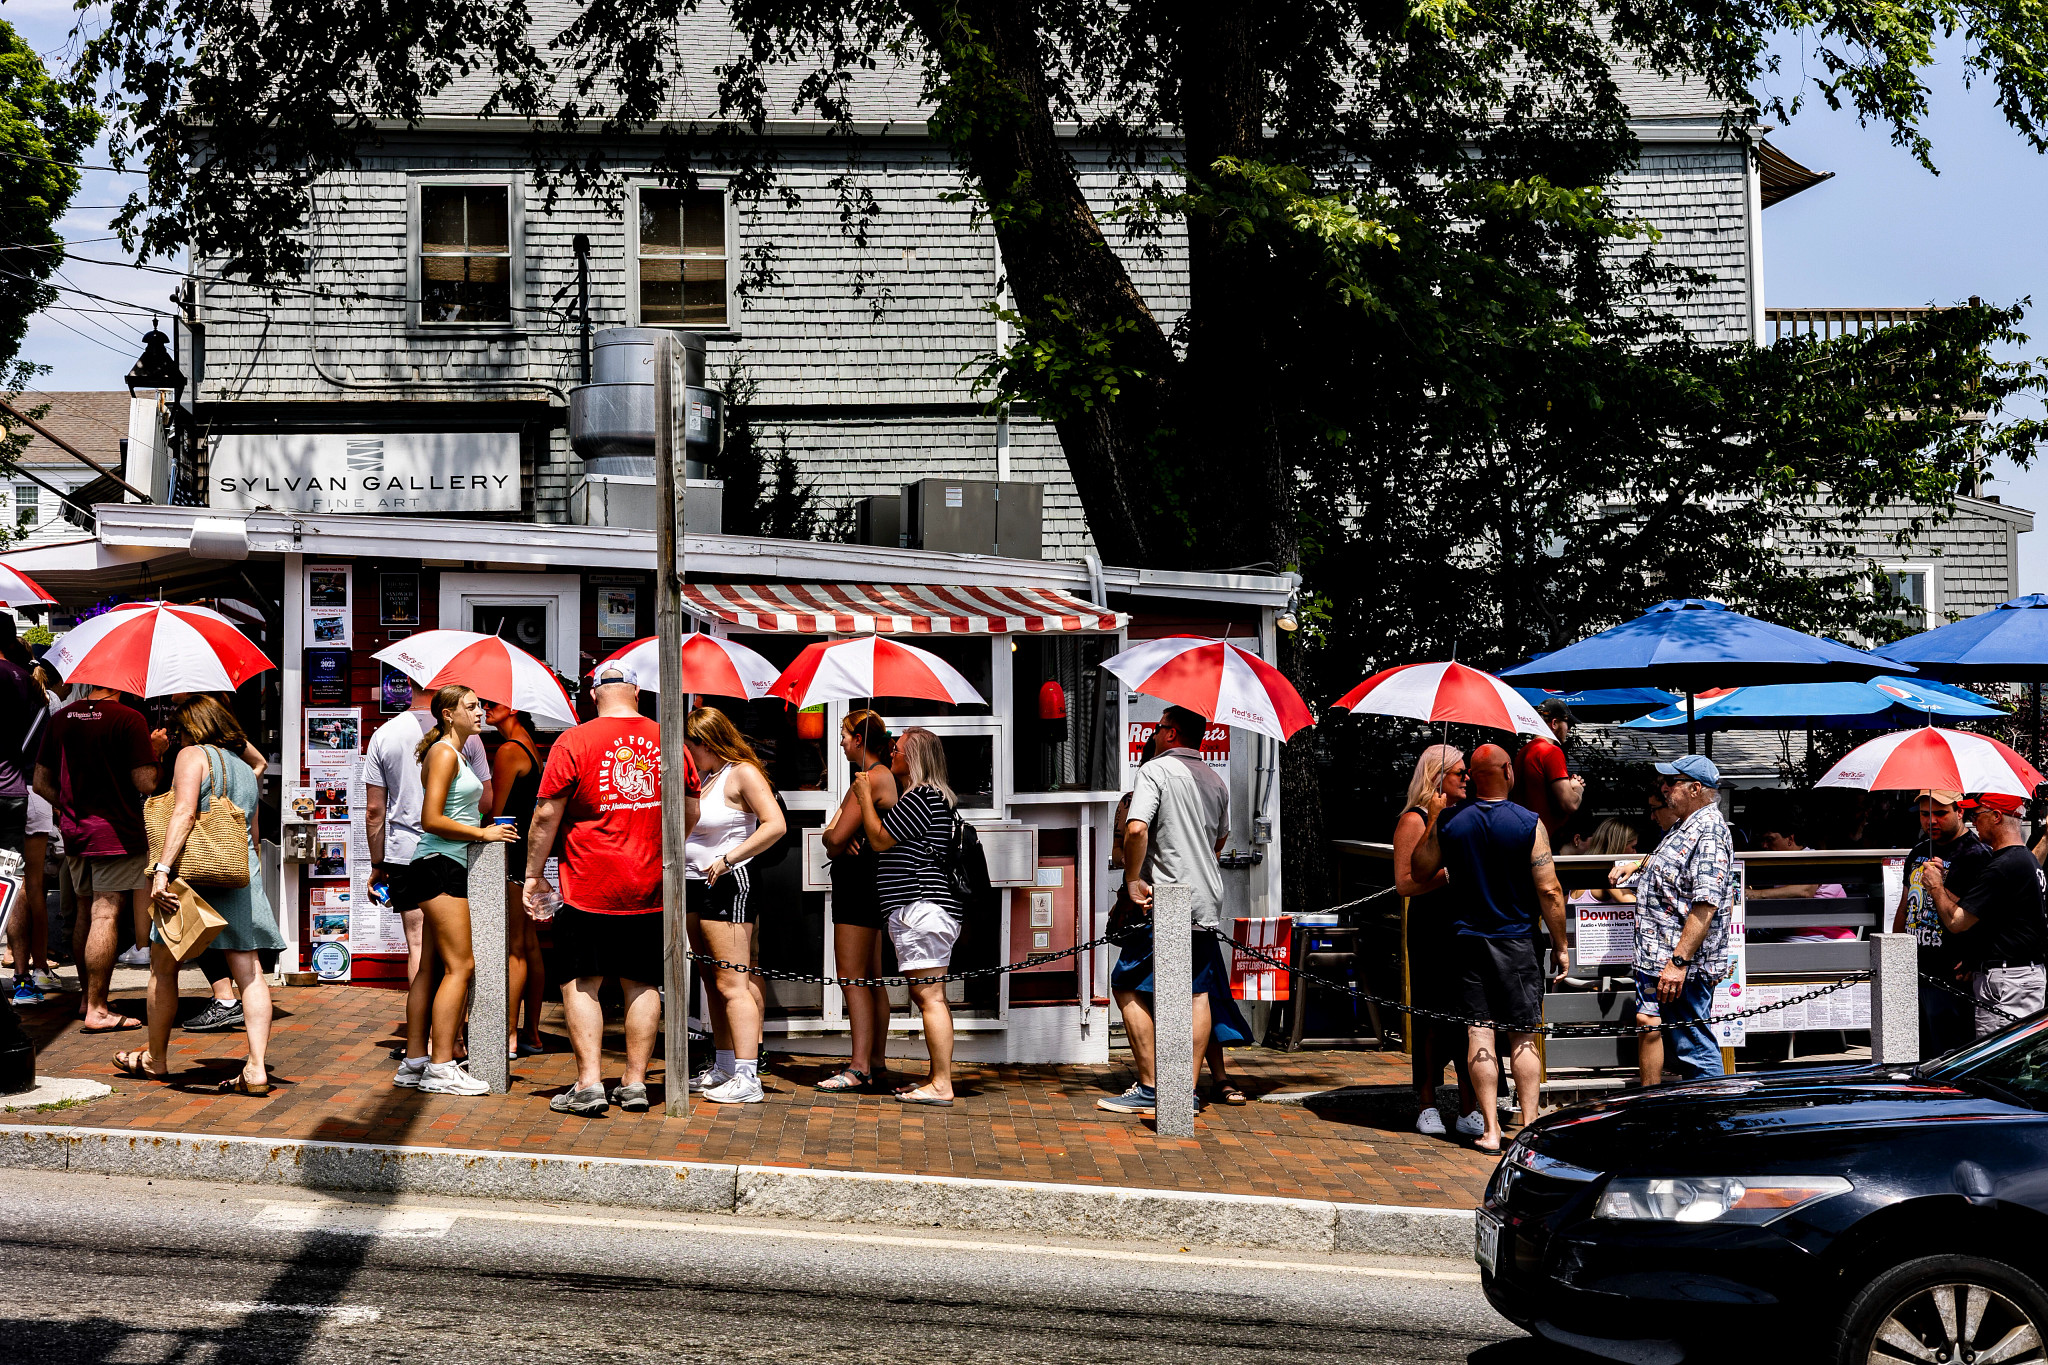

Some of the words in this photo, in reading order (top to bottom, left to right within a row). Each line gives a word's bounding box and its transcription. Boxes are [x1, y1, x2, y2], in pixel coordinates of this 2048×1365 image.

[220, 477, 347, 492] SYLVAN
[362, 474, 509, 491] GALLERY
[313, 498, 364, 508] FINE
[377, 498, 420, 507] ART
[1232, 707, 1251, 718] Red's
[1129, 723, 1156, 743] Re
[1202, 727, 1227, 741] ats
[613, 737, 623, 747] OF
[599, 750, 614, 792] KINGS
[1580, 909, 1635, 921] Downea
